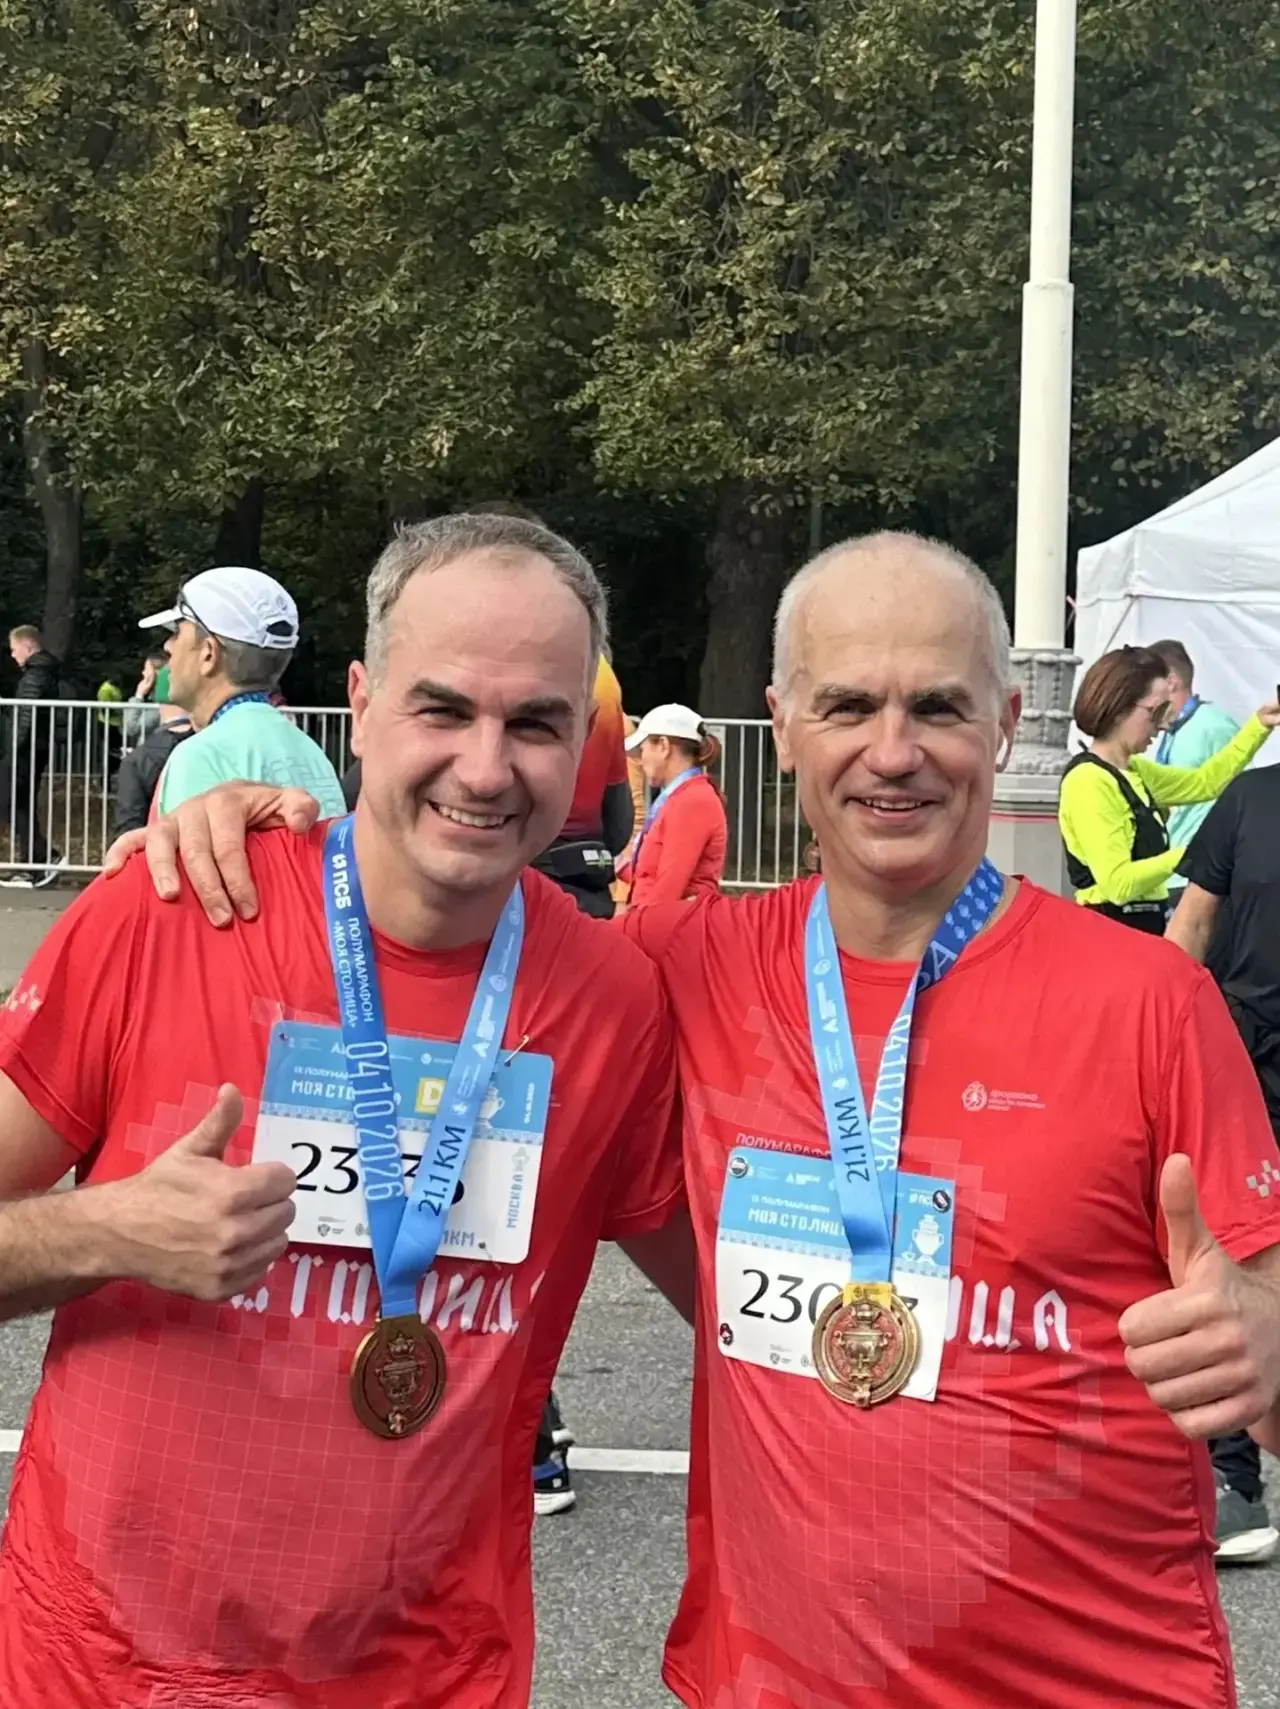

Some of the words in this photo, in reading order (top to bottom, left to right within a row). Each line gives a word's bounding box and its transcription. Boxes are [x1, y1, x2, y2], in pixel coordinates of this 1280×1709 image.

[332, 870, 352, 909] ПСБ
[348, 917, 375, 1022] ПОЛУМАРАФОН
[291, 1080, 324, 1096] МОЯ
[325, 1083, 356, 1101] СТО
[842, 1144, 870, 1184] 21.1
[417, 1174, 451, 1217] 21.1
[505, 1173, 525, 1229] МОСКВА
[747, 1207, 779, 1225] МОЯ
